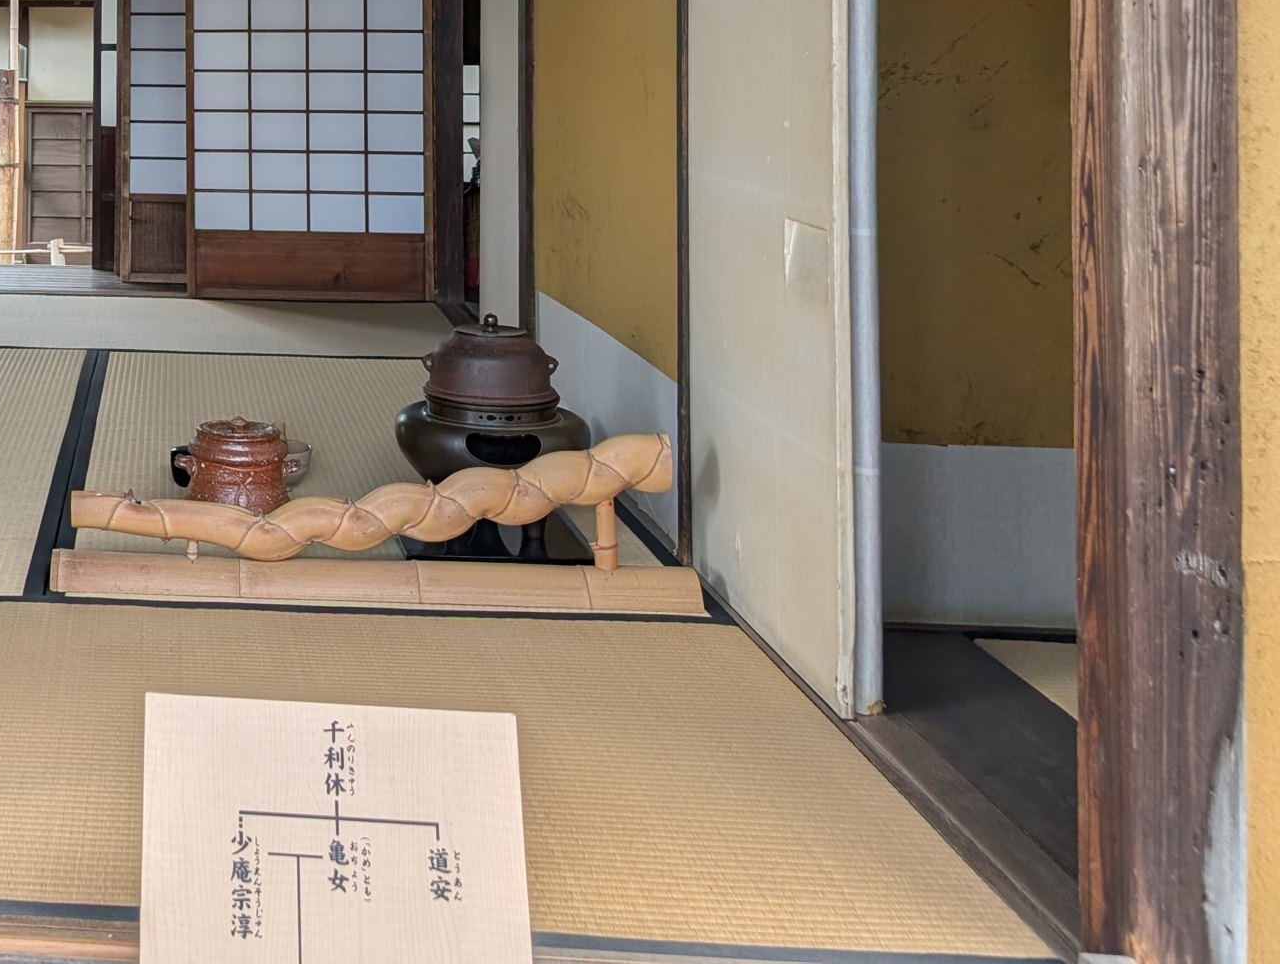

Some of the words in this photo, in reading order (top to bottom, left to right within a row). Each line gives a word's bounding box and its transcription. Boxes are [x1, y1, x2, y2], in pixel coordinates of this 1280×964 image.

[323, 720, 346, 796] 千利休
[230, 830, 253, 939] 少庵宗淳
[327, 839, 349, 893] 亀女
[428, 847, 452, 902] 道安
[453, 850, 462, 901] とうあん
